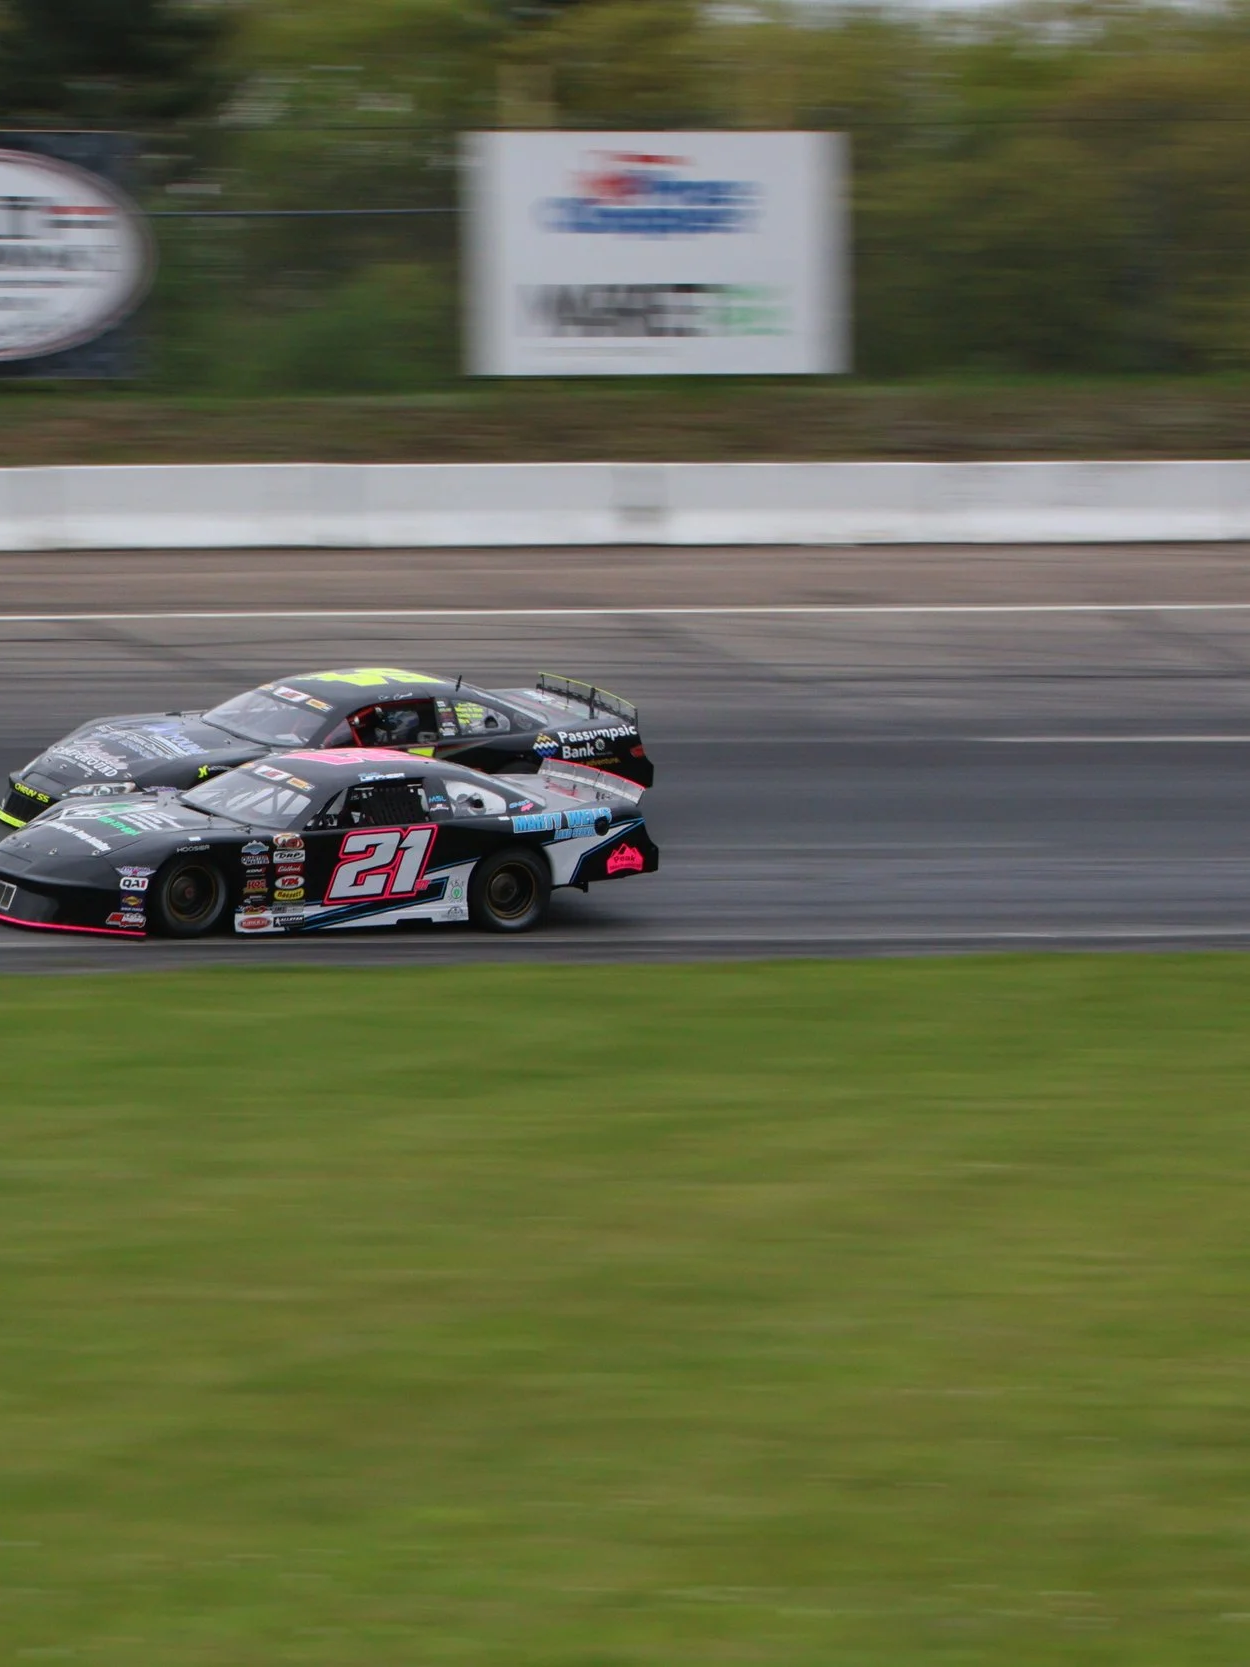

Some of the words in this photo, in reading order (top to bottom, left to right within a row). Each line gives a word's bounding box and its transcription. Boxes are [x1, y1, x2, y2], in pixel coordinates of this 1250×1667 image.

[557, 724, 638, 744] Passumpsic
[561, 742, 596, 759] Bank
[176, 844, 210, 853] HOOSIER
[324, 823, 439, 906] 21
[122, 879, 146, 889] QA1
